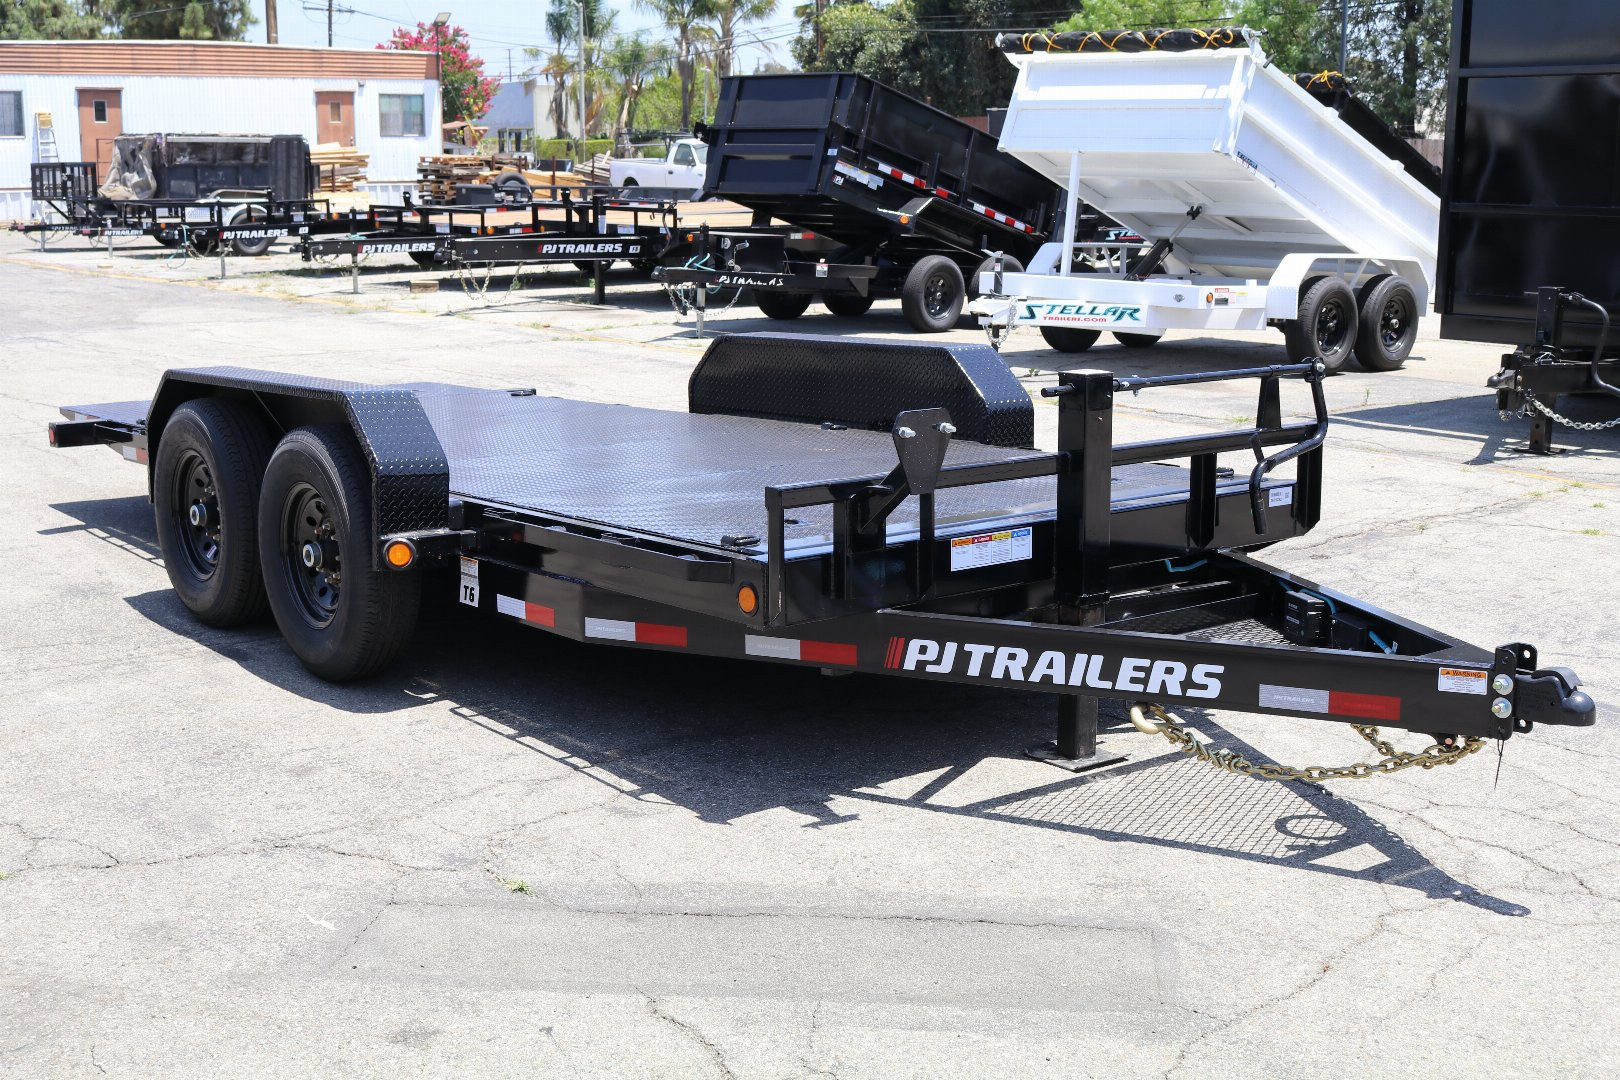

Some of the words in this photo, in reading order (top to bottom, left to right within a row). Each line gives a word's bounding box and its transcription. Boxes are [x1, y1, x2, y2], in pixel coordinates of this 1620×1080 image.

[1019, 303, 1142, 322] STELLAR
[464, 585, 475, 602] T6
[1452, 670, 1482, 678] WARNING
